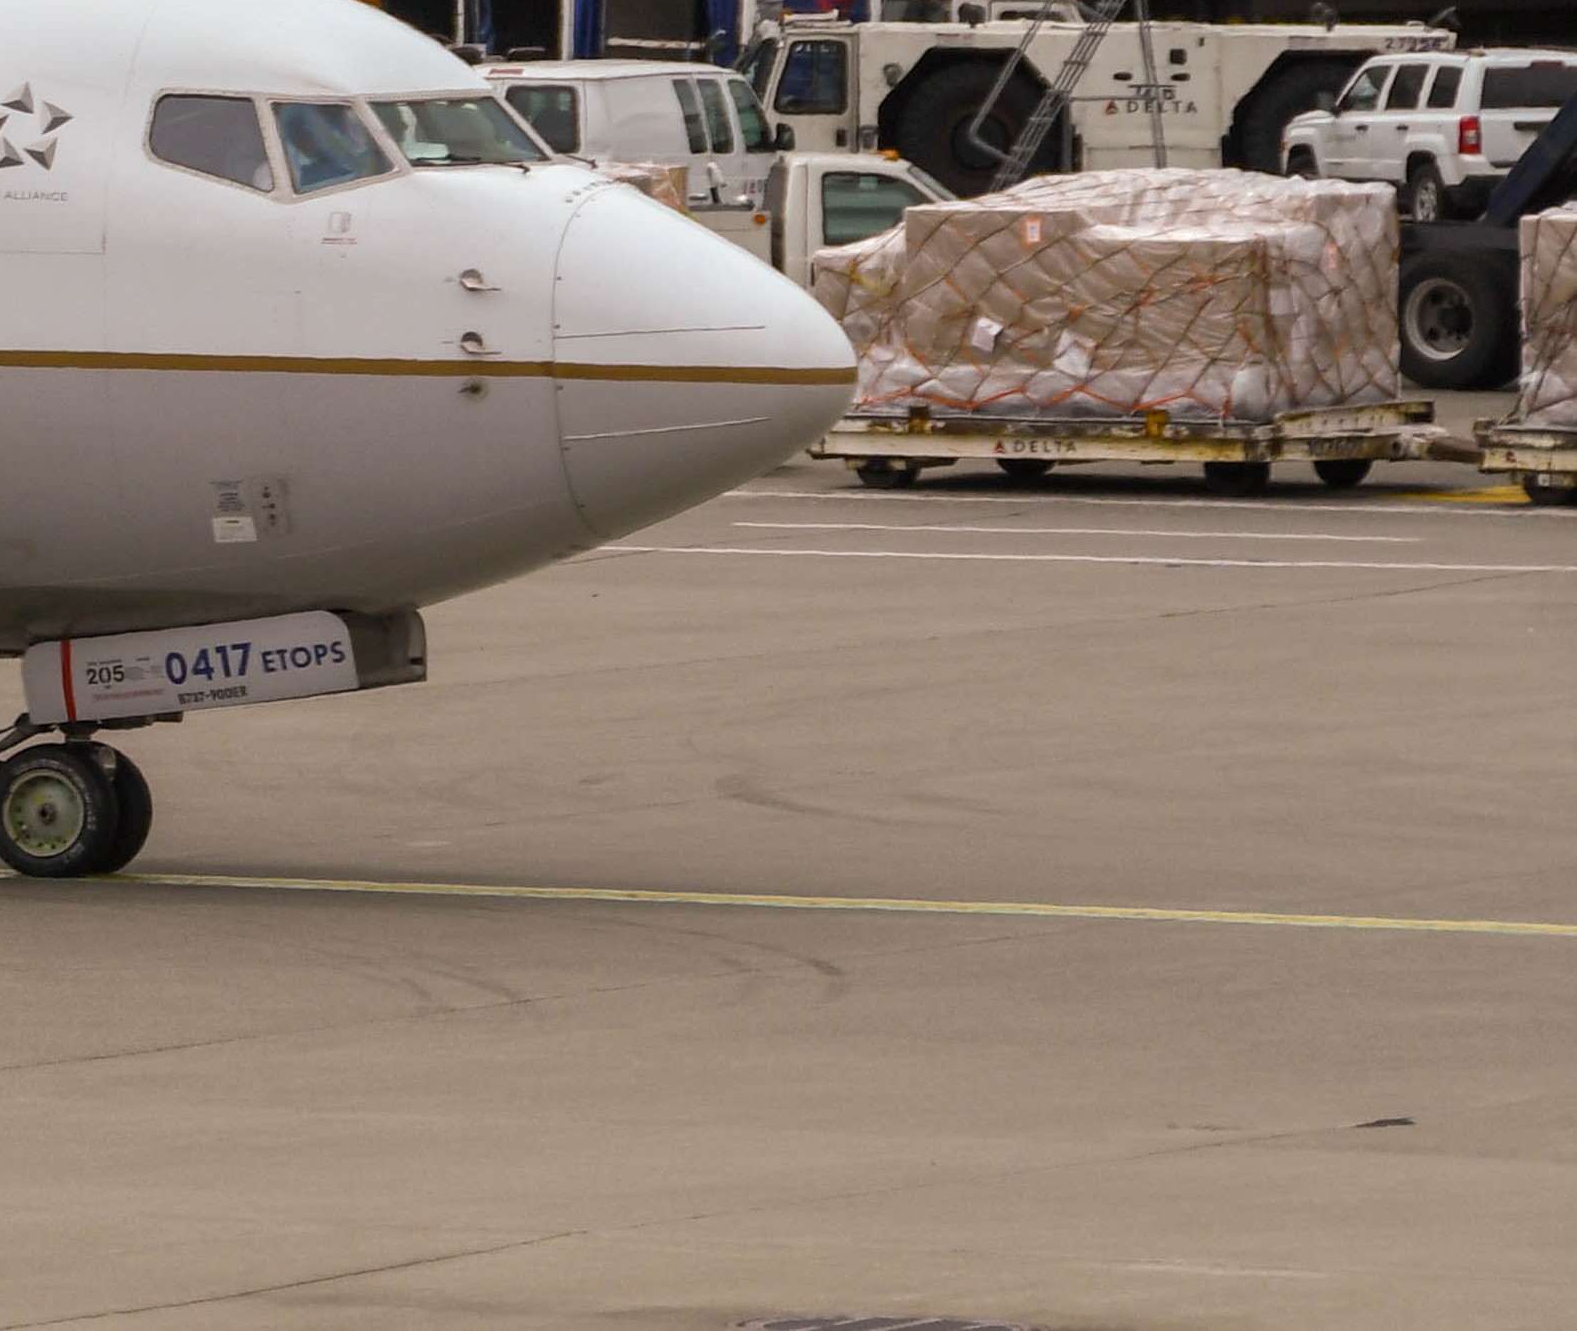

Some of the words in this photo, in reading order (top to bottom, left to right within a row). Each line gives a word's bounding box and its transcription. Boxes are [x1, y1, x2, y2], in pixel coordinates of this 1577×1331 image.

[1127, 100, 1197, 114] DELTA
[4, 190, 68, 201] ALLIANCE
[1013, 440, 1077, 453] DELTA
[86, 665, 125, 685] 205
[165, 642, 251, 685] 0417
[261, 641, 345, 673] ETOPS
